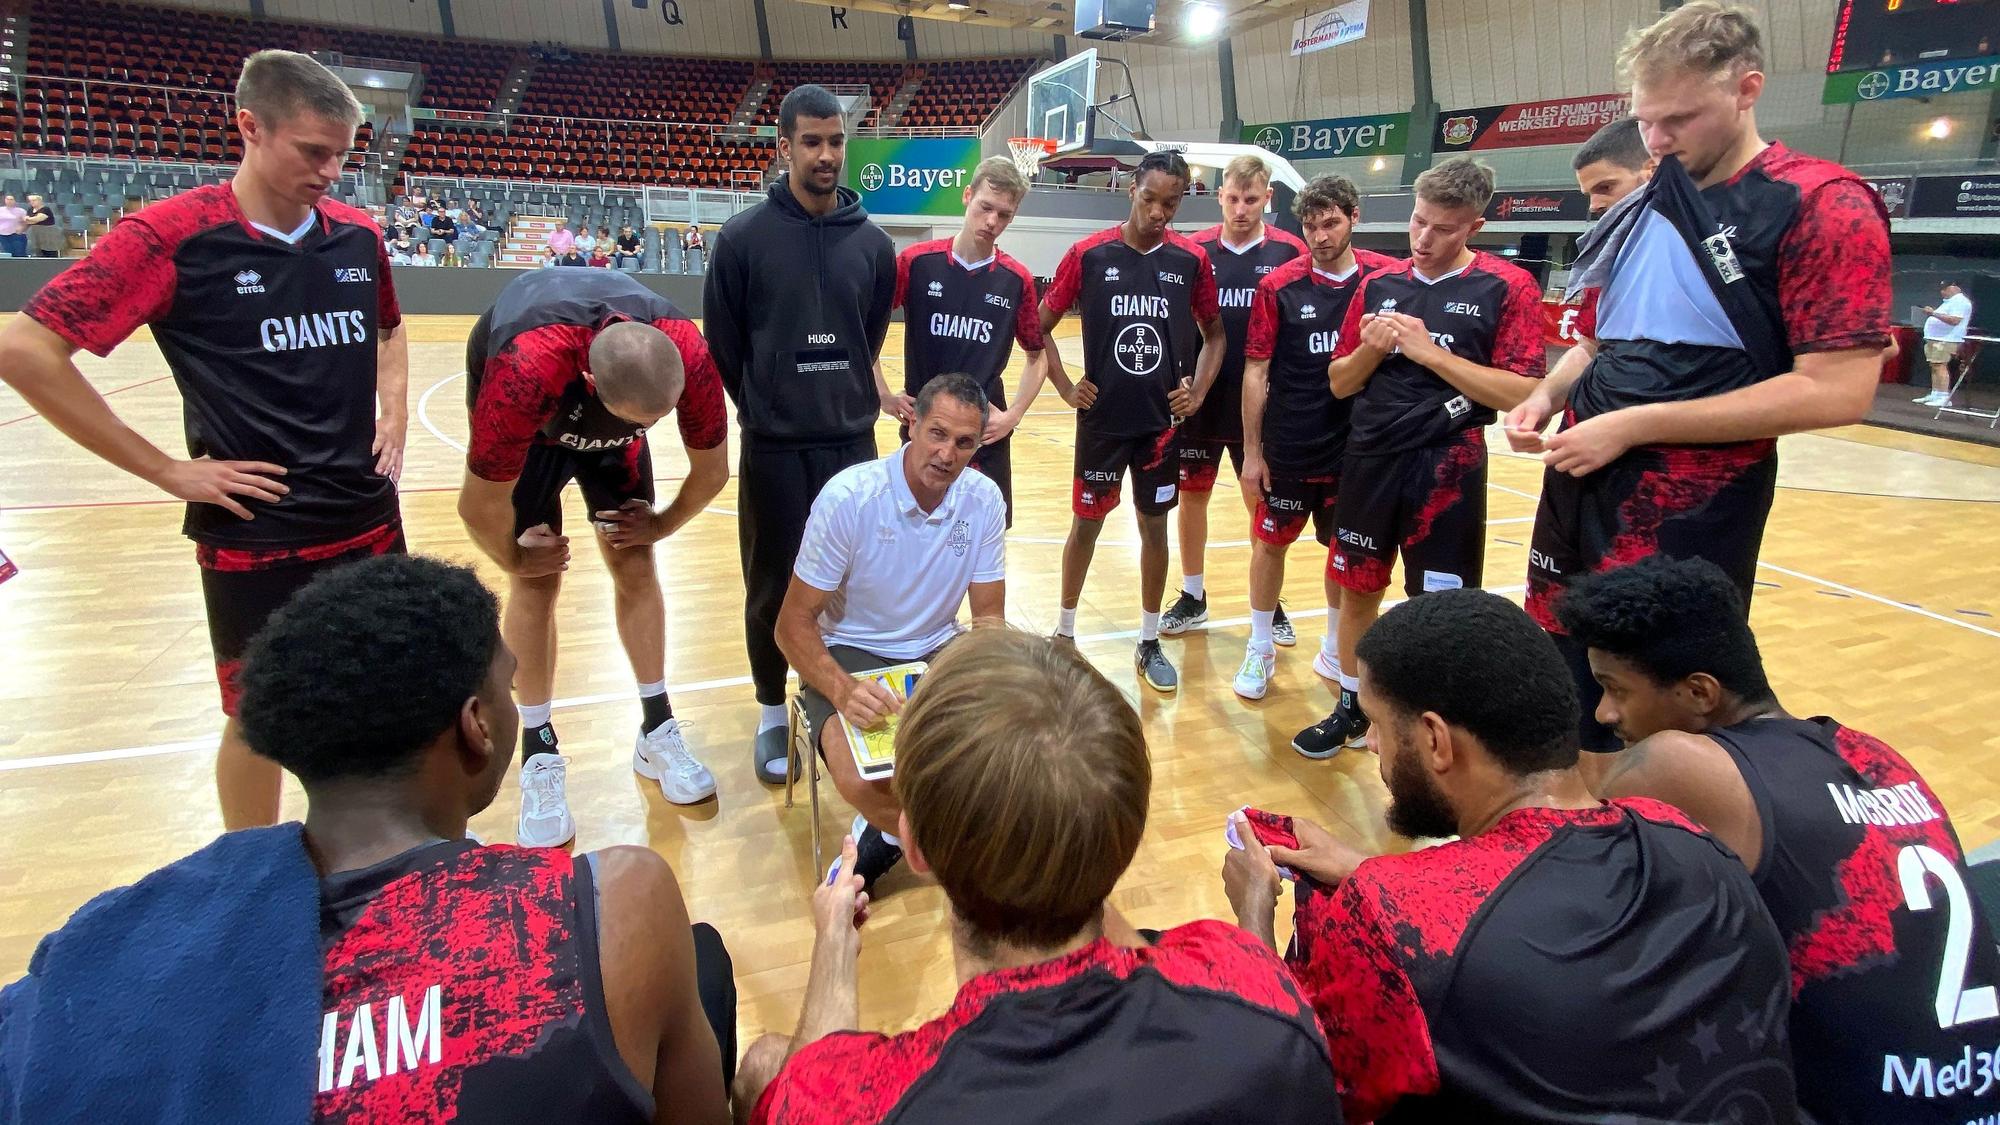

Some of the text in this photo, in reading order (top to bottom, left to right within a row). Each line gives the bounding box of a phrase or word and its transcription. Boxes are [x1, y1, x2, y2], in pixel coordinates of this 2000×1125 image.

[662, 0, 684, 25] Q
[830, 6, 848, 29] R
[1894, 63, 2000, 93] Bayer
[1519, 105, 1559, 120] ALLES
[1560, 102, 1598, 116] RUND
[1599, 99, 1621, 113] UM
[1498, 117, 1564, 133] WERKSELF
[1288, 123, 1395, 155] Bayer
[888, 164, 967, 192] Bayer
[348, 268, 372, 282] EVL
[1167, 272, 1185, 285] EVL
[1263, 265, 1280, 274] EV
[993, 295, 1011, 309] EVL
[1110, 294, 1169, 319] GIANTS
[1217, 287, 1256, 308] IANT
[1455, 302, 1481, 317] EVL
[260, 310, 366, 353] GIANTS
[807, 333, 836, 344] HUGO
[930, 312, 993, 344] GIANTS
[1118, 344, 1160, 355] BAYER
[1308, 330, 1340, 354] GIA
[1187, 449, 1210, 459] EVL
[1095, 471, 1120, 482] EVL
[1279, 498, 1304, 511] EVL
[1349, 530, 1378, 550] EVL
[1530, 548, 1561, 574] EVL
[1897, 844, 2000, 1029] 2
